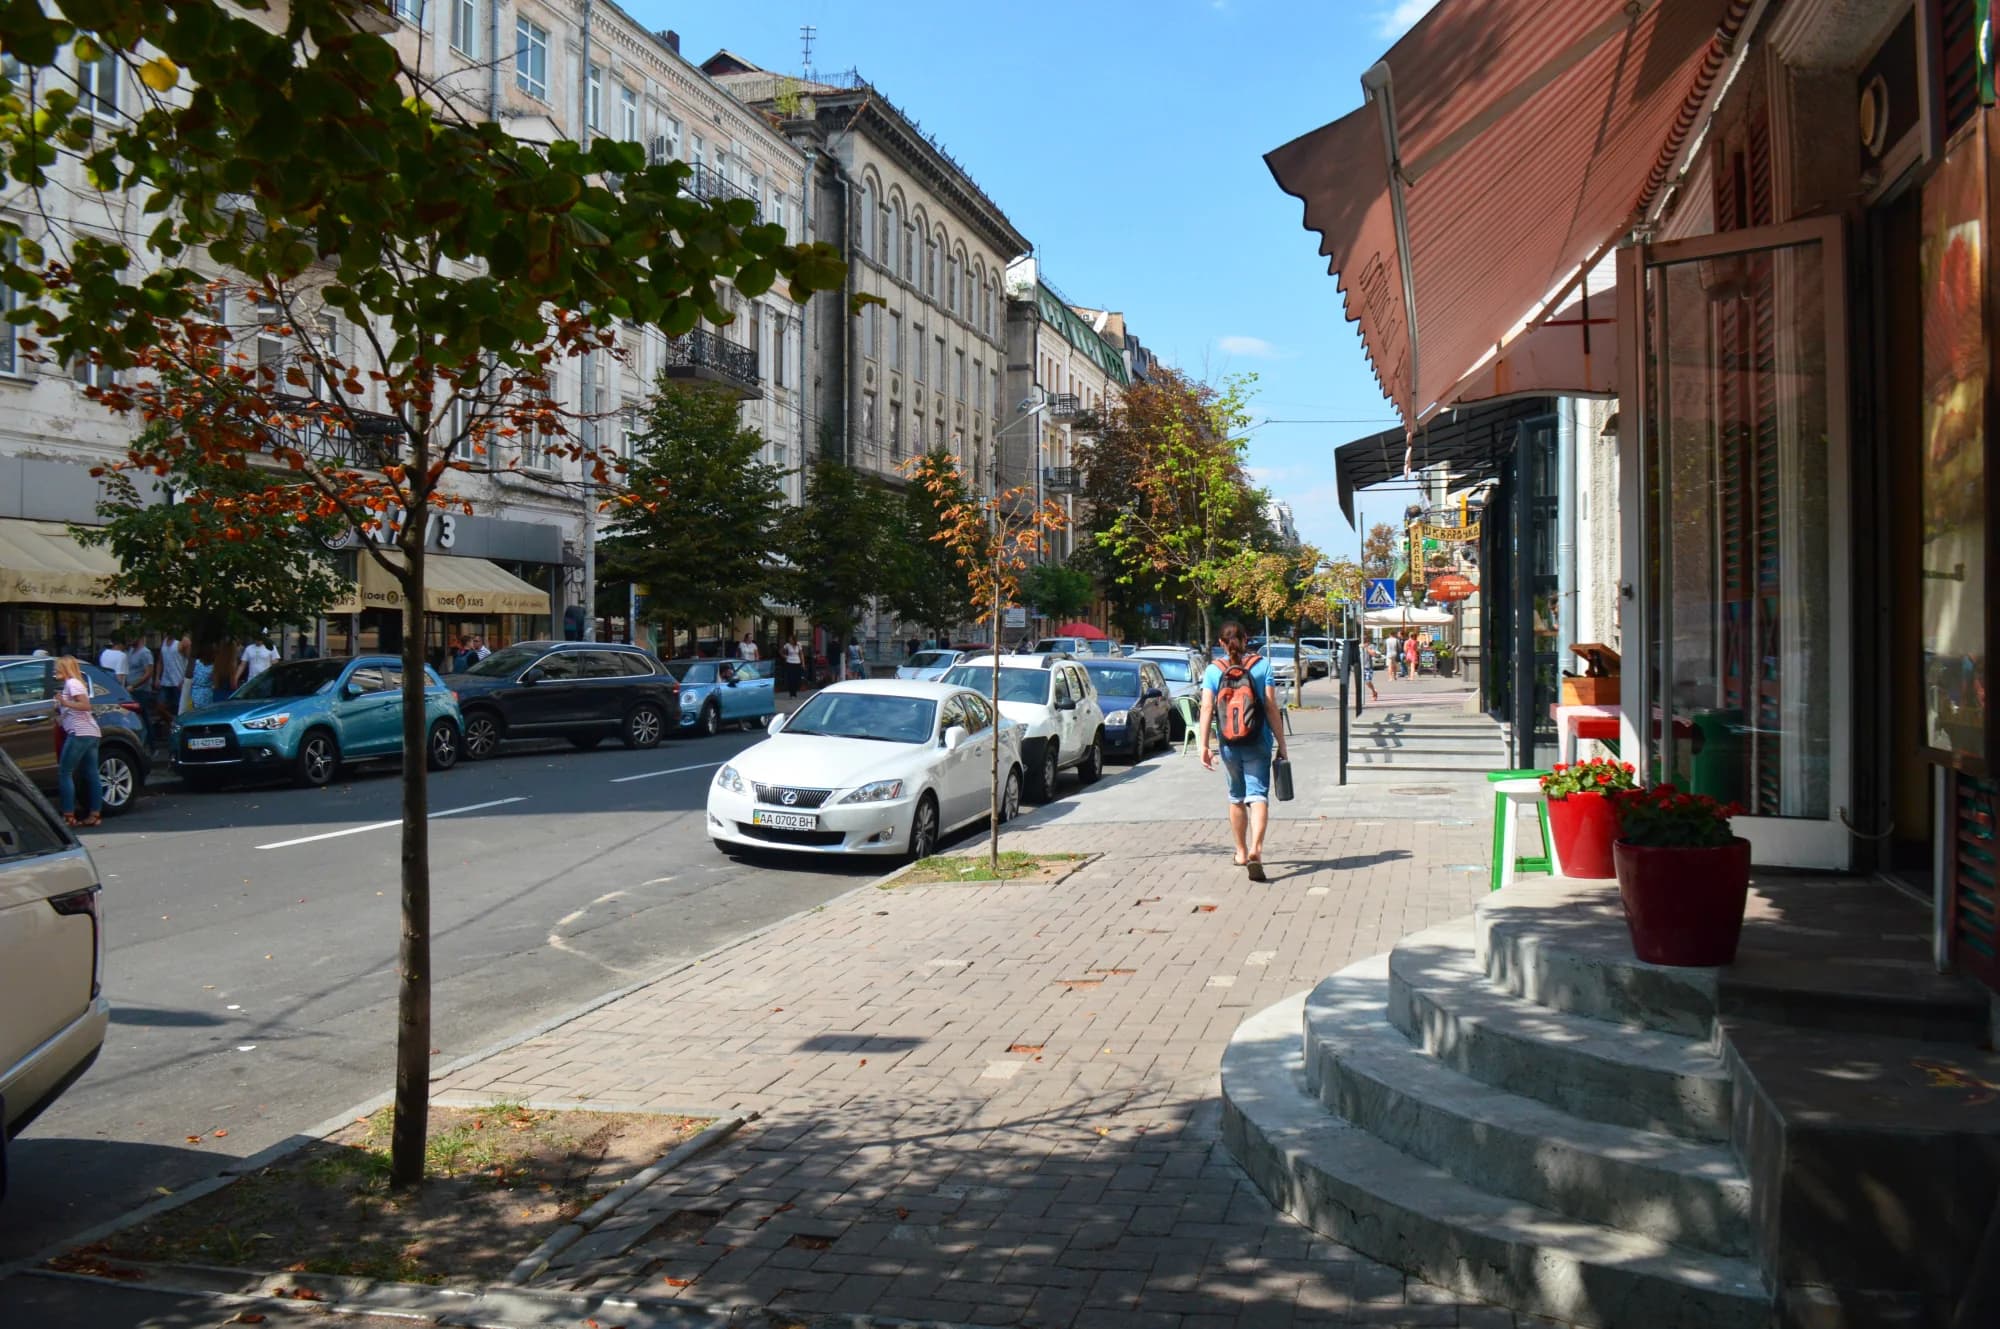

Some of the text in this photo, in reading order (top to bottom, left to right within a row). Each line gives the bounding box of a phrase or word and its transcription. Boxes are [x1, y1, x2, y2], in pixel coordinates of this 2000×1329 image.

[760, 814, 813, 827] AA 0702 BH
